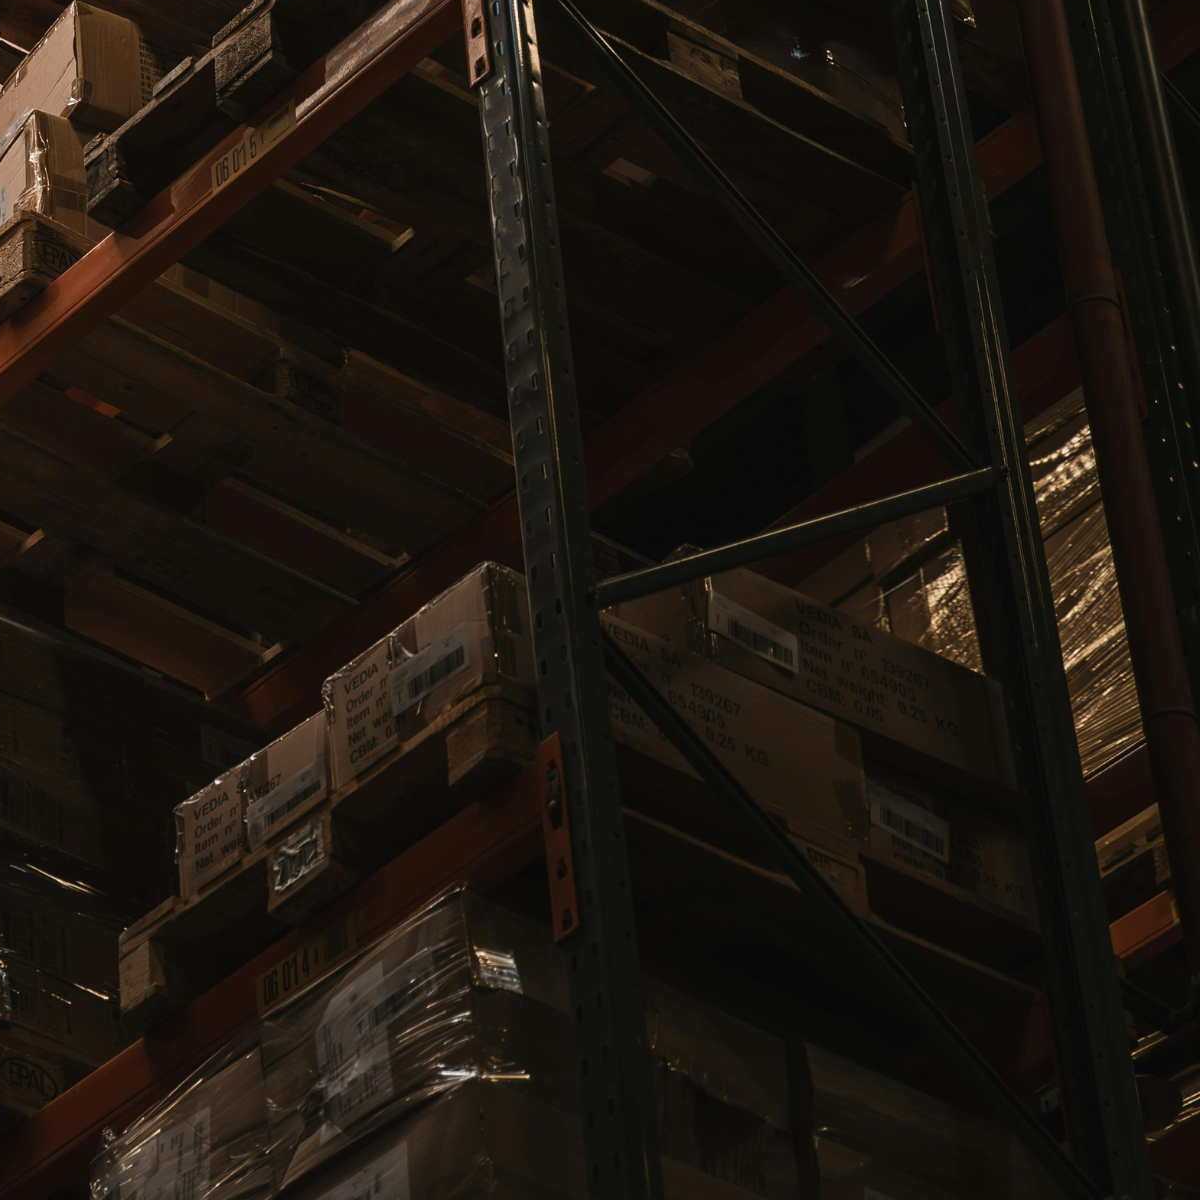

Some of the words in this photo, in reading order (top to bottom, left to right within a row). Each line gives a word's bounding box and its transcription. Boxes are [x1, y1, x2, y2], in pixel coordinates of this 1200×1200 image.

[215, 156, 229, 187] 06
[232, 142, 247, 174] 01
[249, 133, 257, 159] 5
[796, 599, 842, 632] VEDIA
[852, 625, 873, 646] SA
[799, 621, 843, 650] Order
[661, 647, 682, 669] SA
[801, 638, 832, 664] Item
[861, 665, 916, 702] 654905
[344, 663, 378, 694] VEDIA
[346, 686, 374, 713] Order
[690, 682, 741, 716] 139267
[803, 658, 828, 680] Net
[935, 715, 960, 737] KG
[806, 679, 846, 707] CBM:
[347, 707, 370, 730] Item
[668, 690, 725, 728] 654905
[348, 726, 366, 747] Net
[350, 736, 380, 764] CBM:
[745, 744, 769, 767] KG
[194, 791, 228, 820] VEDIA
[194, 814, 223, 838] Order
[195, 834, 218, 854] Item
[196, 852, 214, 872] Net
[1005, 881, 1025, 900] KG
[263, 970, 278, 1005] 06
[283, 954, 298, 992] 01
[302, 947, 310, 977] 4
[9, 1061, 52, 1099] EPAL
